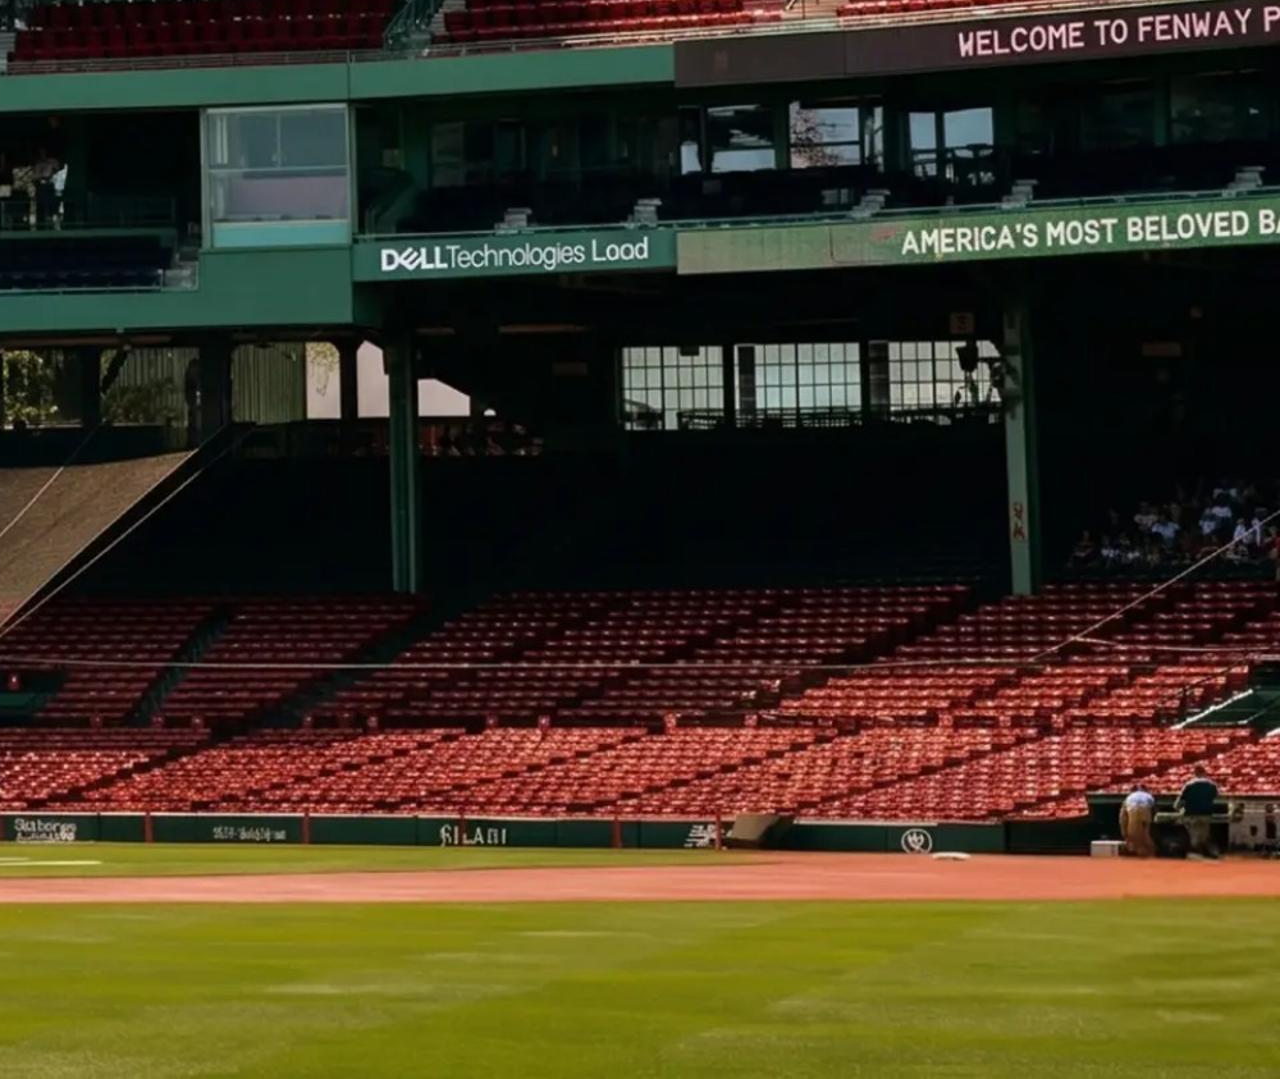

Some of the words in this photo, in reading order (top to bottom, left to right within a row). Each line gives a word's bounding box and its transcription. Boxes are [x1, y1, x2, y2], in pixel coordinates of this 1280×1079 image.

[958, 22, 1085, 57] WELCOME
[1094, 19, 1128, 46] TO
[1138, 8, 1252, 43] FENWAY
[901, 223, 1038, 255] AMERICA'S
[1046, 218, 1118, 247] MOST
[1127, 210, 1249, 242] BELOVED
[446, 243, 586, 270] Technologies
